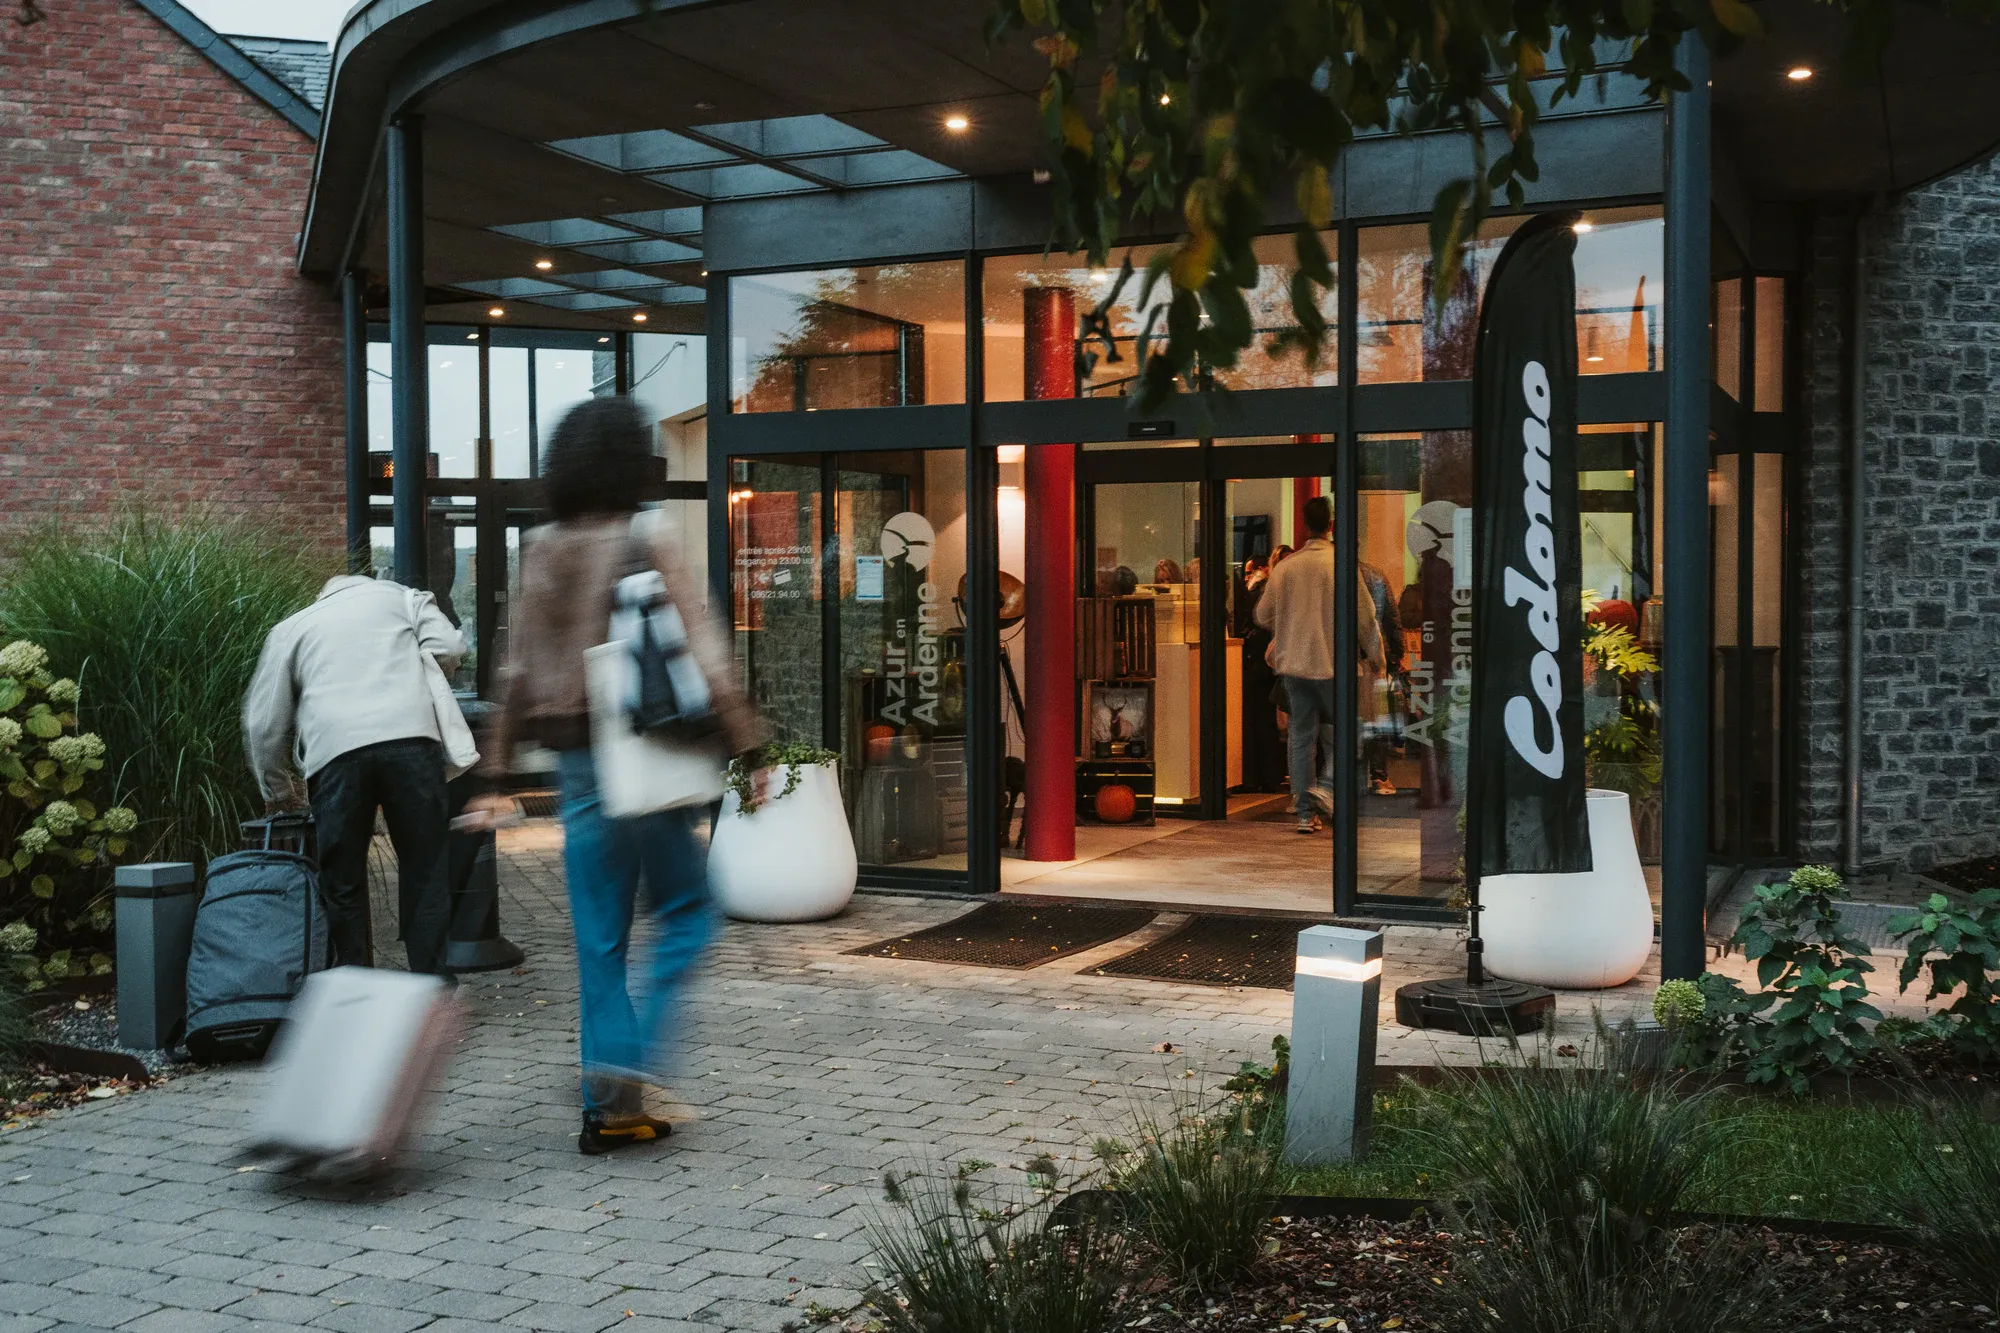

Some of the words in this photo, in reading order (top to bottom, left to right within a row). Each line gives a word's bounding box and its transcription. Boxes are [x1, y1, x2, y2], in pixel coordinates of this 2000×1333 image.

[735, 558, 766, 567] toegang
[779, 557, 801, 565] 23.00
[738, 546, 763, 554] entrée
[764, 546, 786, 555] après
[1504, 360, 1564, 779] Codomo
[881, 641, 906, 725] Azur
[896, 619, 906, 638] en
[912, 582, 938, 726] Ardenne
[1403, 652, 1434, 747] Azur
[1422, 620, 1434, 643] en
